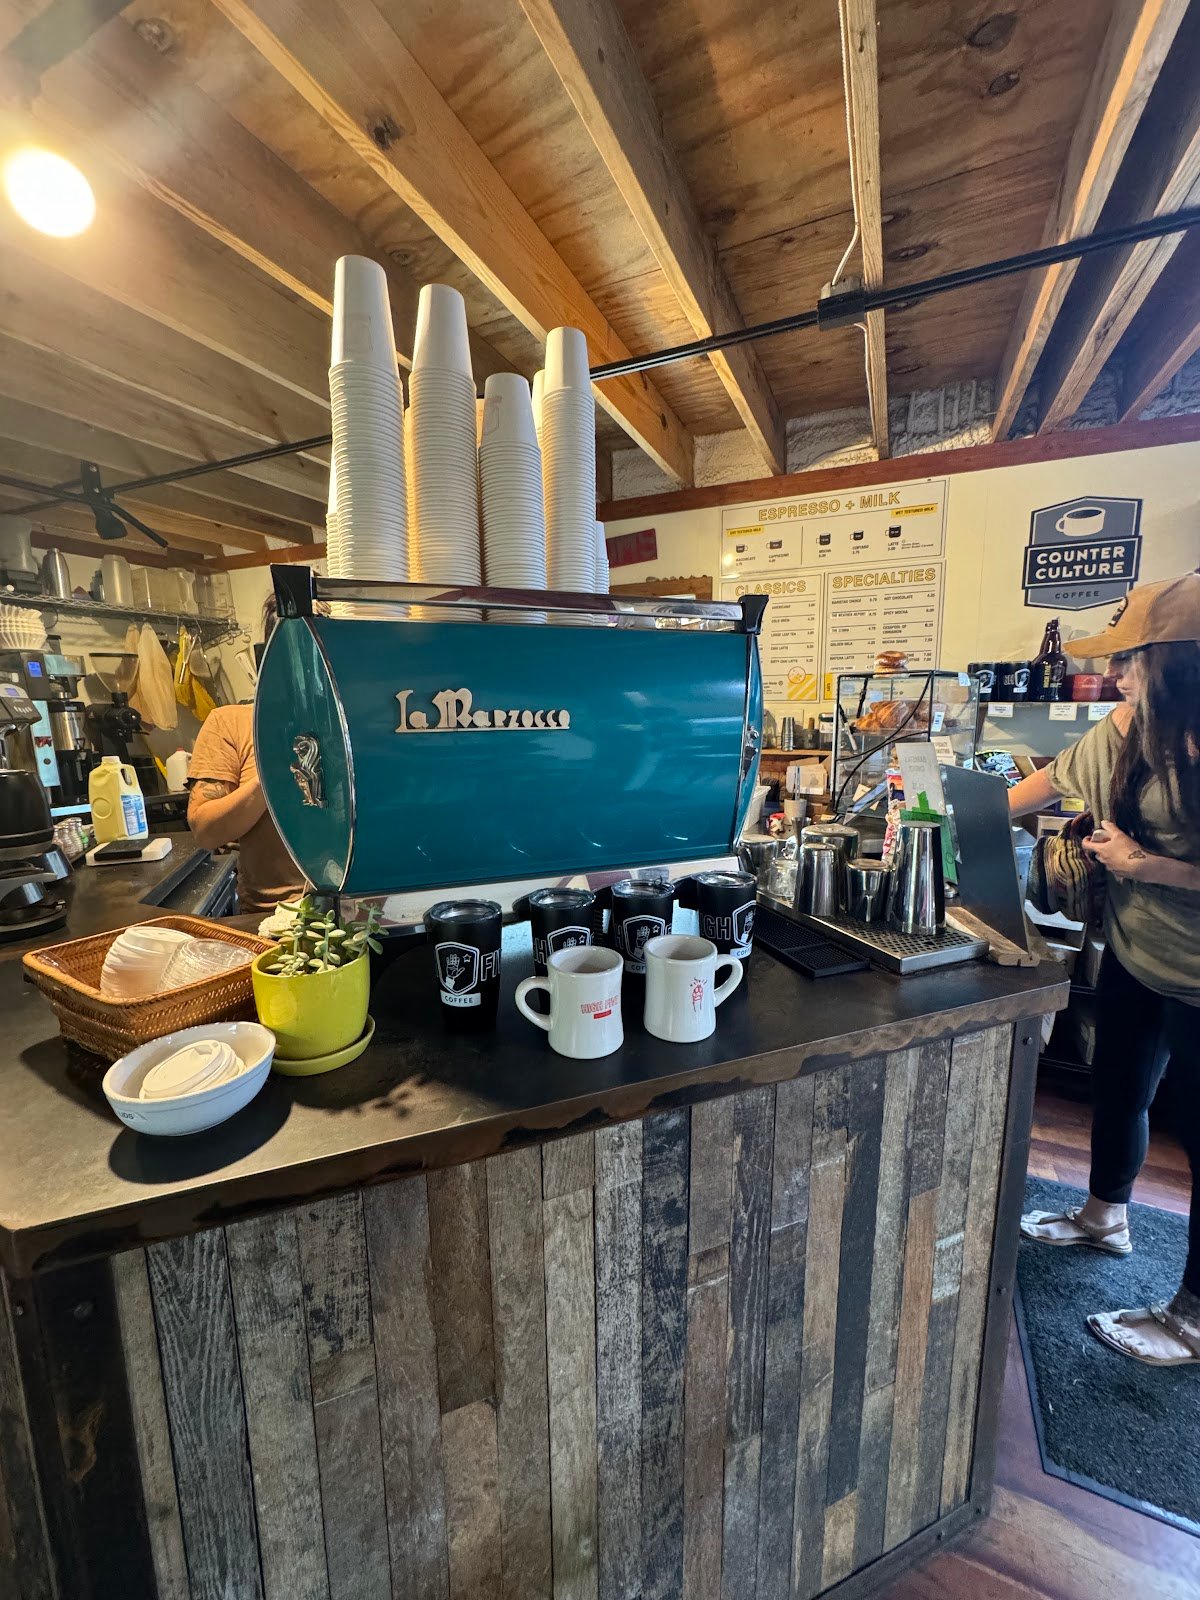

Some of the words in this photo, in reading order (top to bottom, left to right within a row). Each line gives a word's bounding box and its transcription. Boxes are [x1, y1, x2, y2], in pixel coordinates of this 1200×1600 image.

[758, 499, 841, 522] ESPRESSO
[845, 500, 855, 511] +
[859, 491, 901, 509] MILK
[1036, 545, 1126, 566] COUNTER
[832, 567, 936, 589] SPECIALTIES
[1035, 561, 1125, 580] CULTURE
[735, 580, 807, 597] CLASSICS
[1054, 590, 1101, 600] COFFEE
[444, 995, 474, 1004] COFFEE
